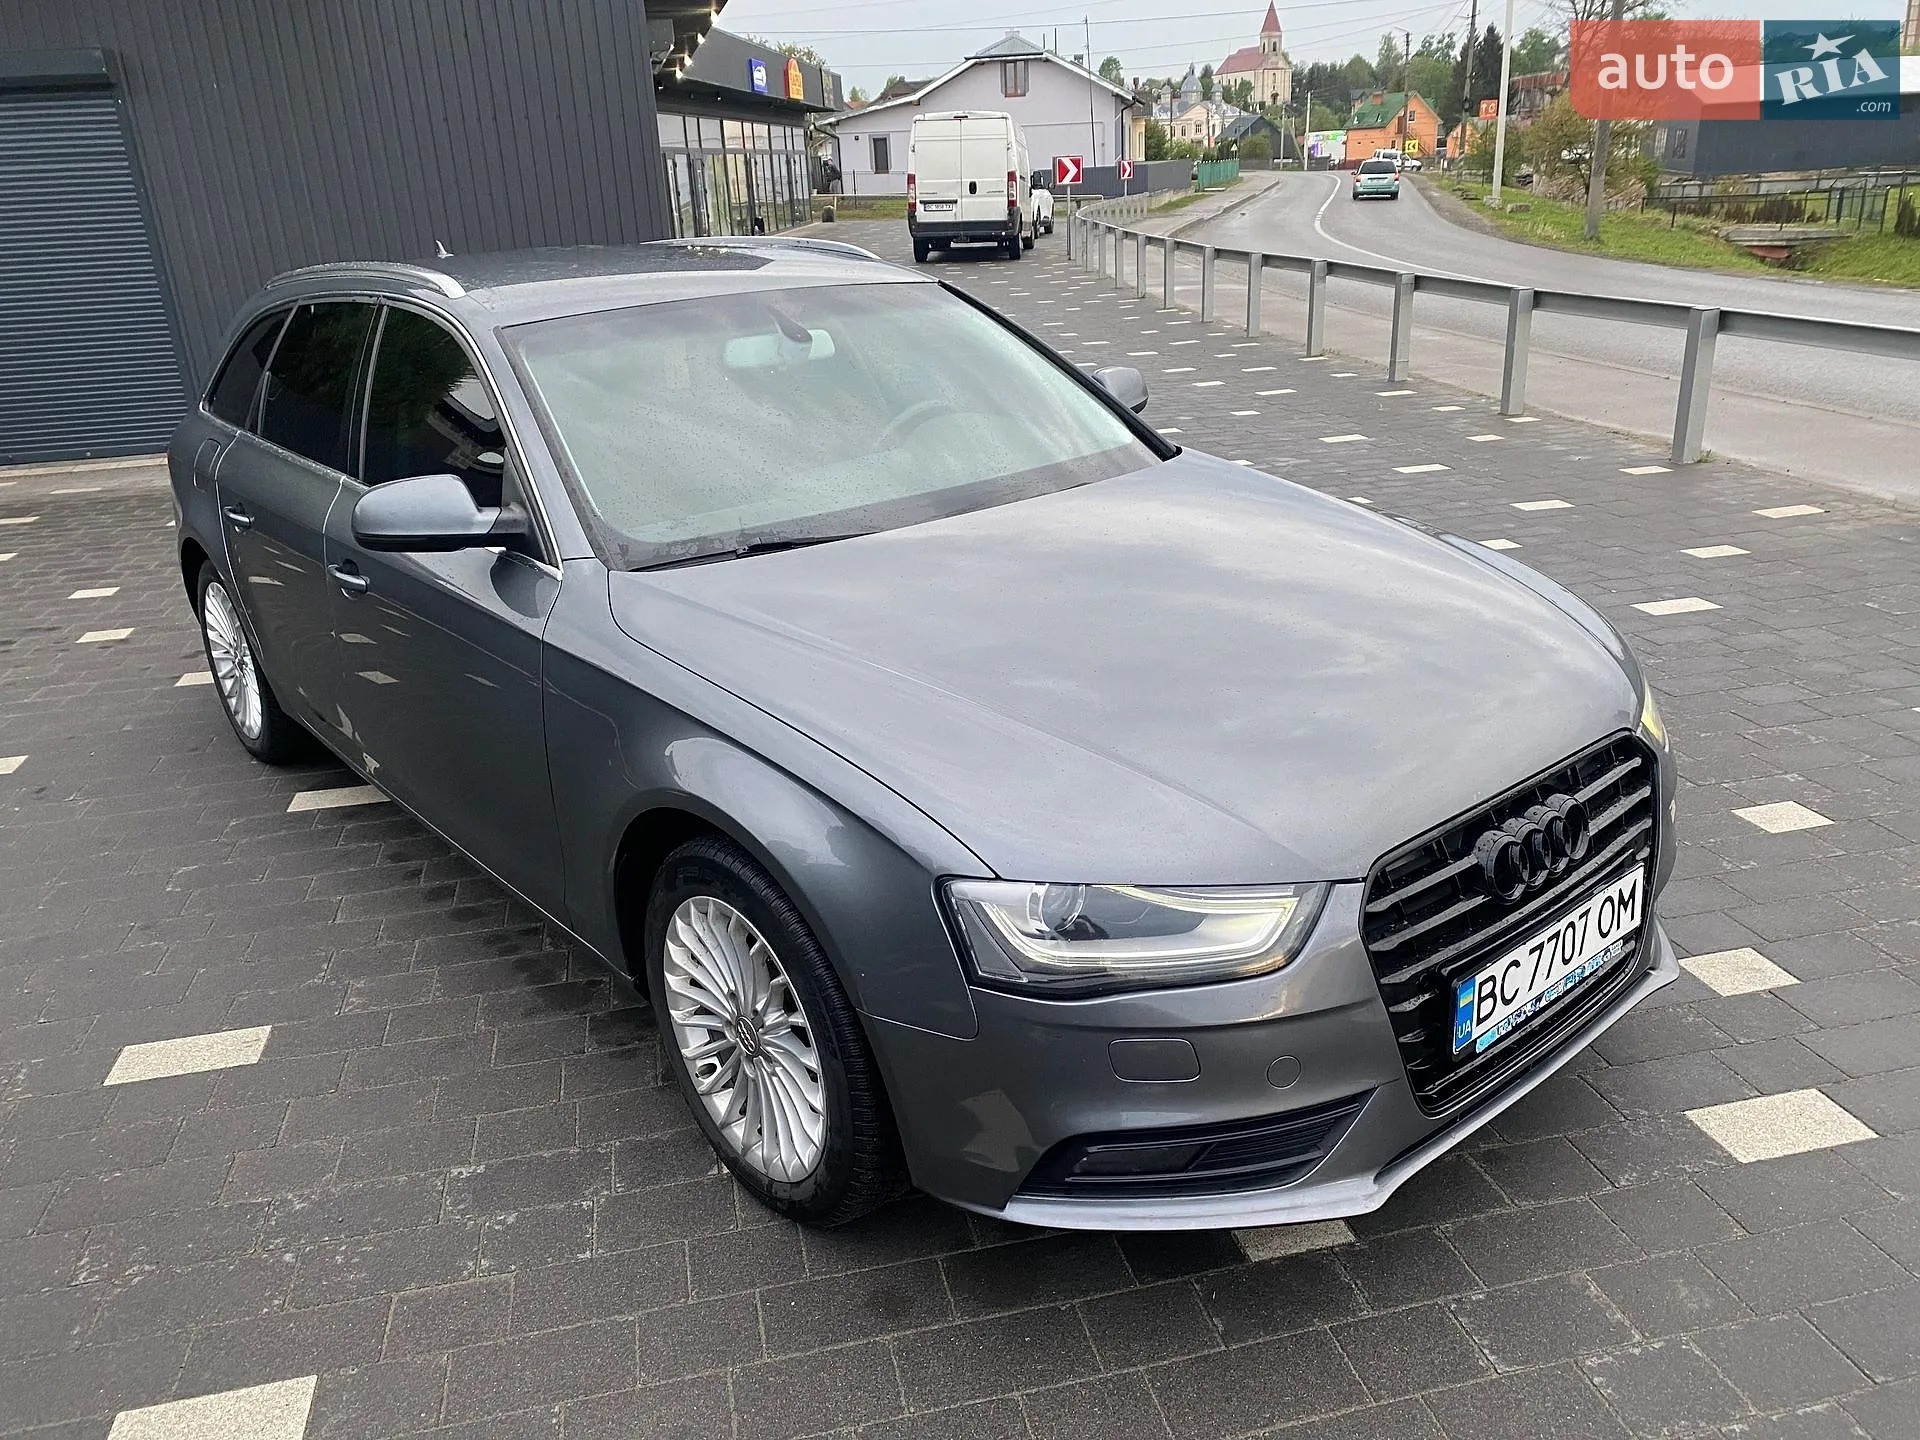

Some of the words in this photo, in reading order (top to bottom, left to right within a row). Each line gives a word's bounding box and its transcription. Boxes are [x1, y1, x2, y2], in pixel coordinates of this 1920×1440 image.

[1475, 959, 1521, 1028] BC
[1527, 906, 1592, 993] 7707
[1597, 878, 1638, 939] OM
[1458, 1020, 1472, 1039] UA
